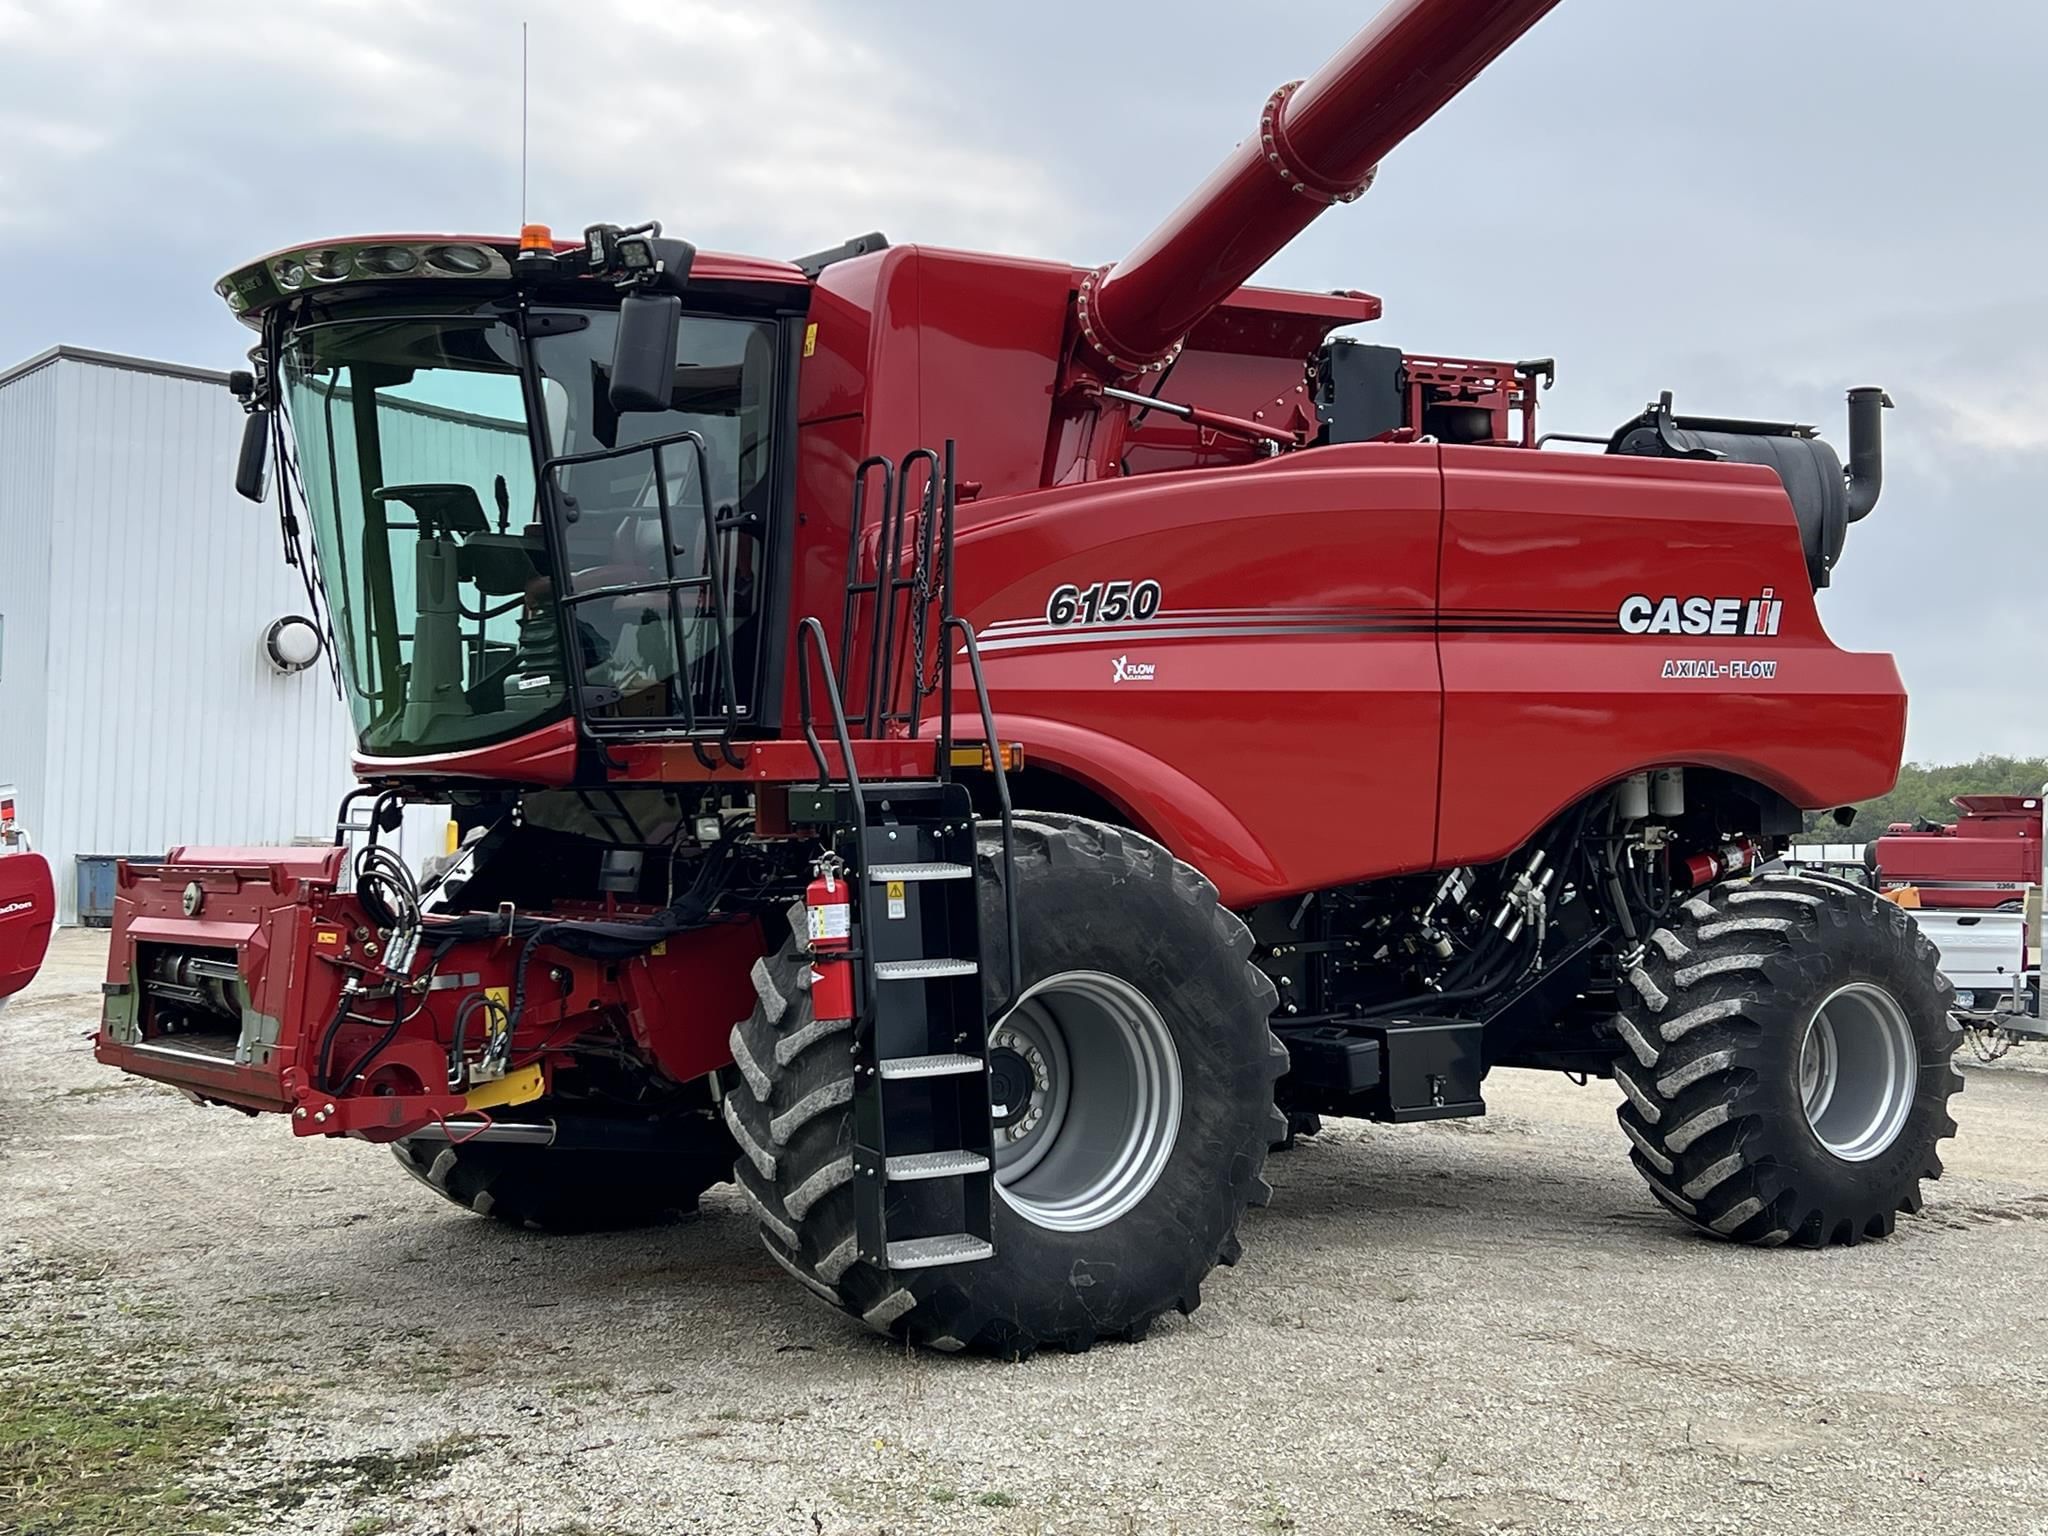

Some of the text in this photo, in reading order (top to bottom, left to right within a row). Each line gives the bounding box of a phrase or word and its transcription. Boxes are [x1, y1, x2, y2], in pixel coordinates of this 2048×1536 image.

[1047, 578, 1162, 627] 6150
[1617, 594, 1742, 636] CASE
[1661, 659, 1777, 679] AXIAL-FLOW
